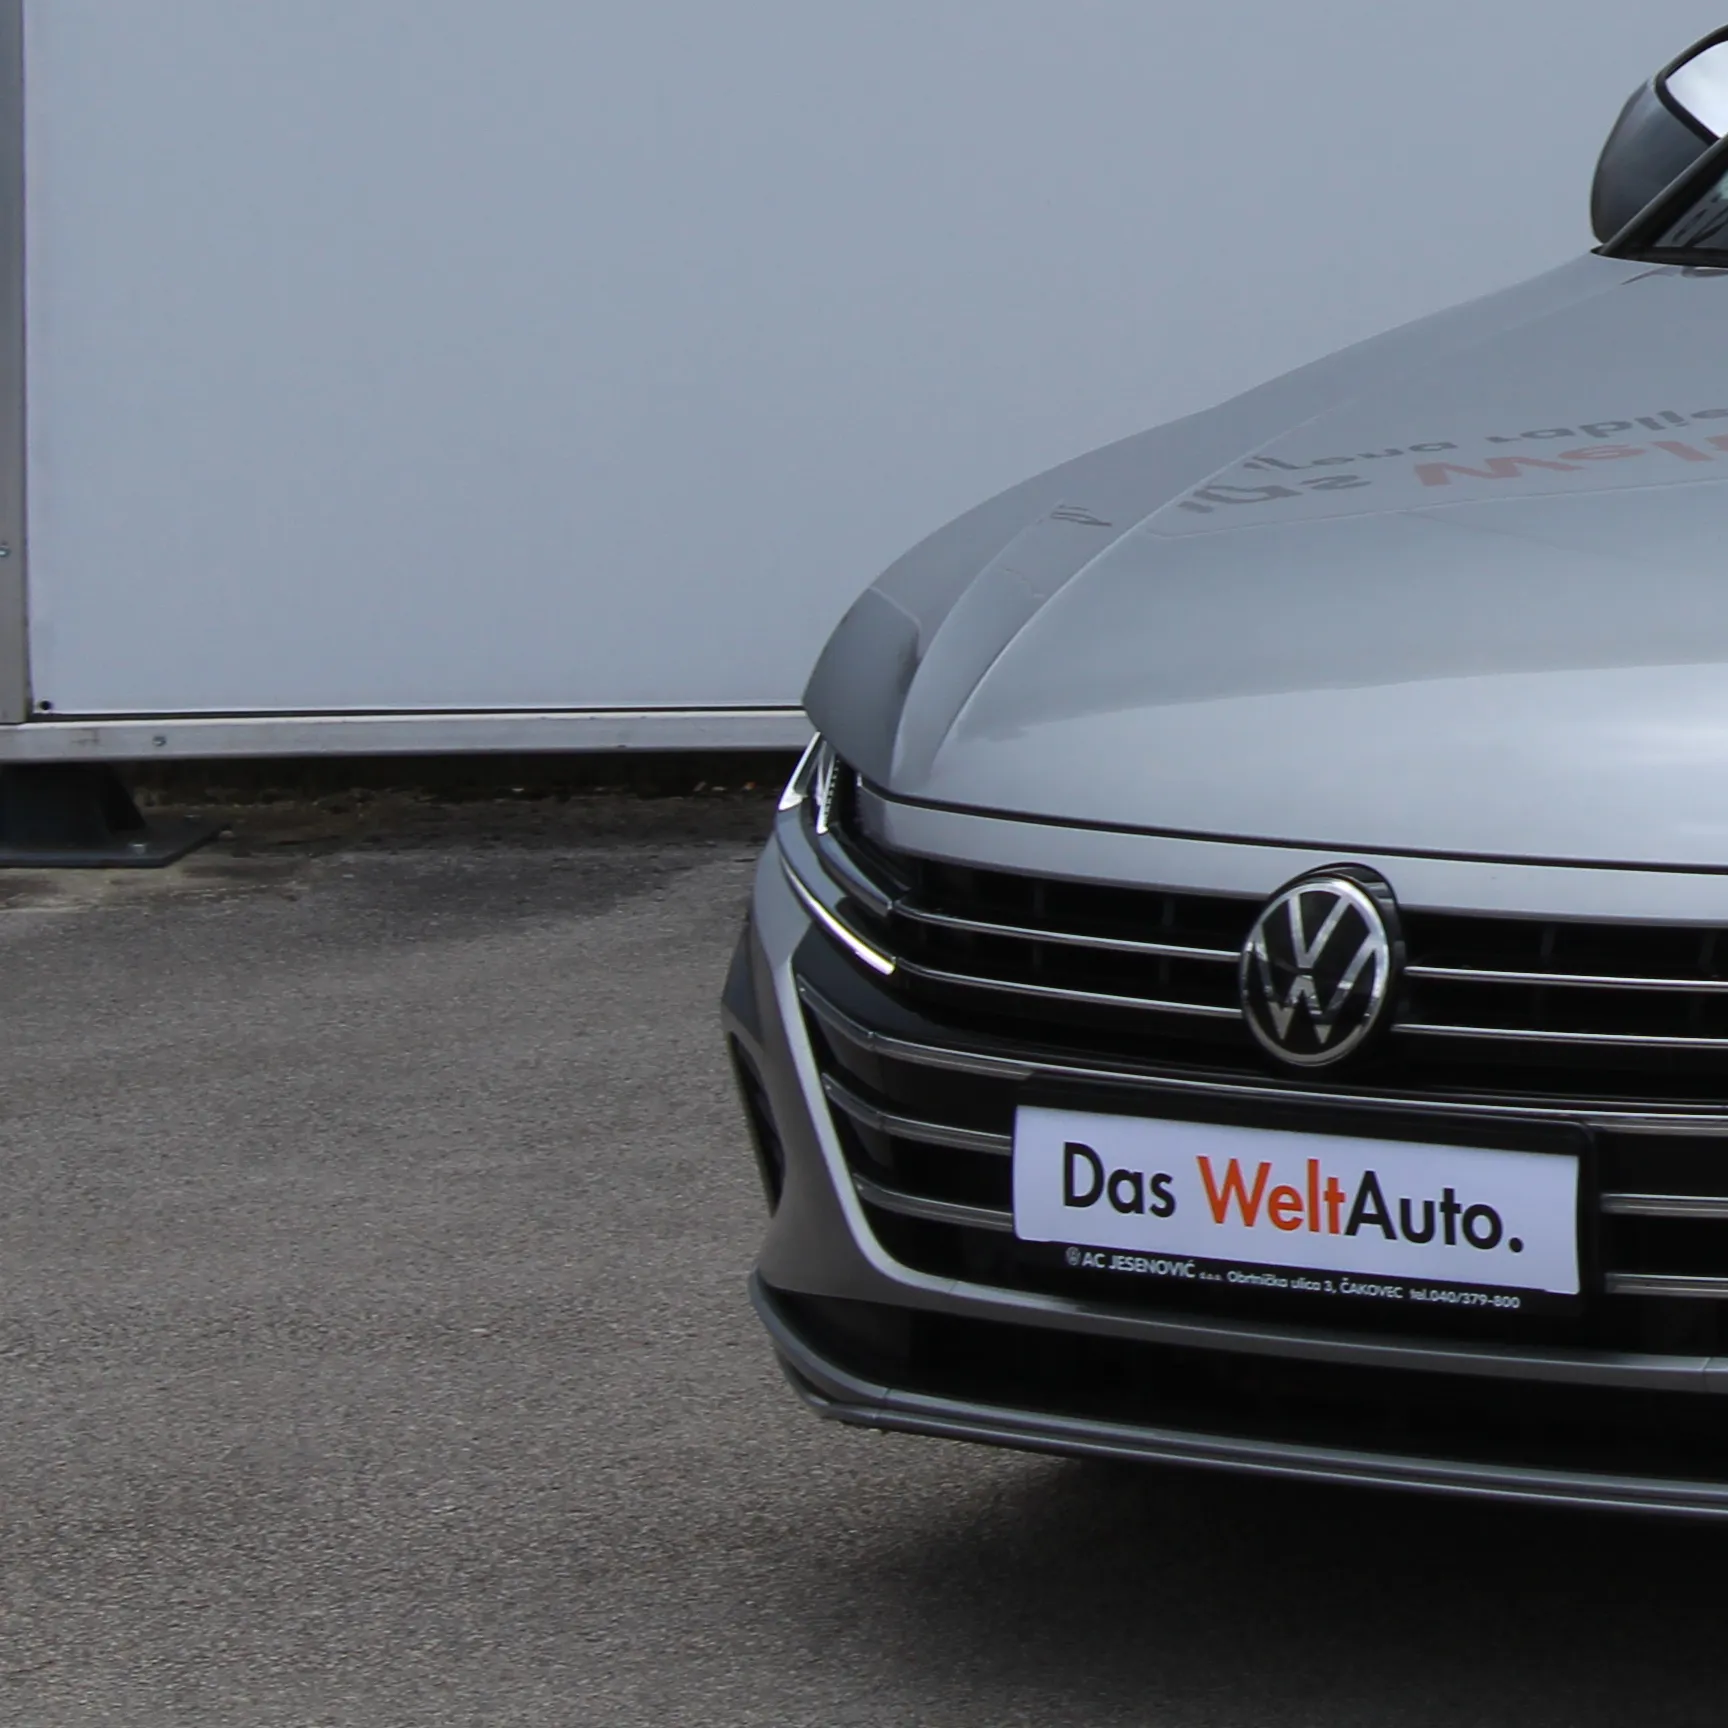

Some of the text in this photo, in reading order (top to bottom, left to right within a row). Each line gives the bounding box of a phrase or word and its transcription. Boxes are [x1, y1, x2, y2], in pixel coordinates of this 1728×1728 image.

[1062, 1141, 1524, 1254] Das WeltAuto.
[1082, 1251, 1106, 1269] AC
[1109, 1254, 1196, 1279] JESENOVIĆ
[1291, 1276, 1321, 1291] ulica
[1339, 1276, 1404, 1299] ČAKOVEC
